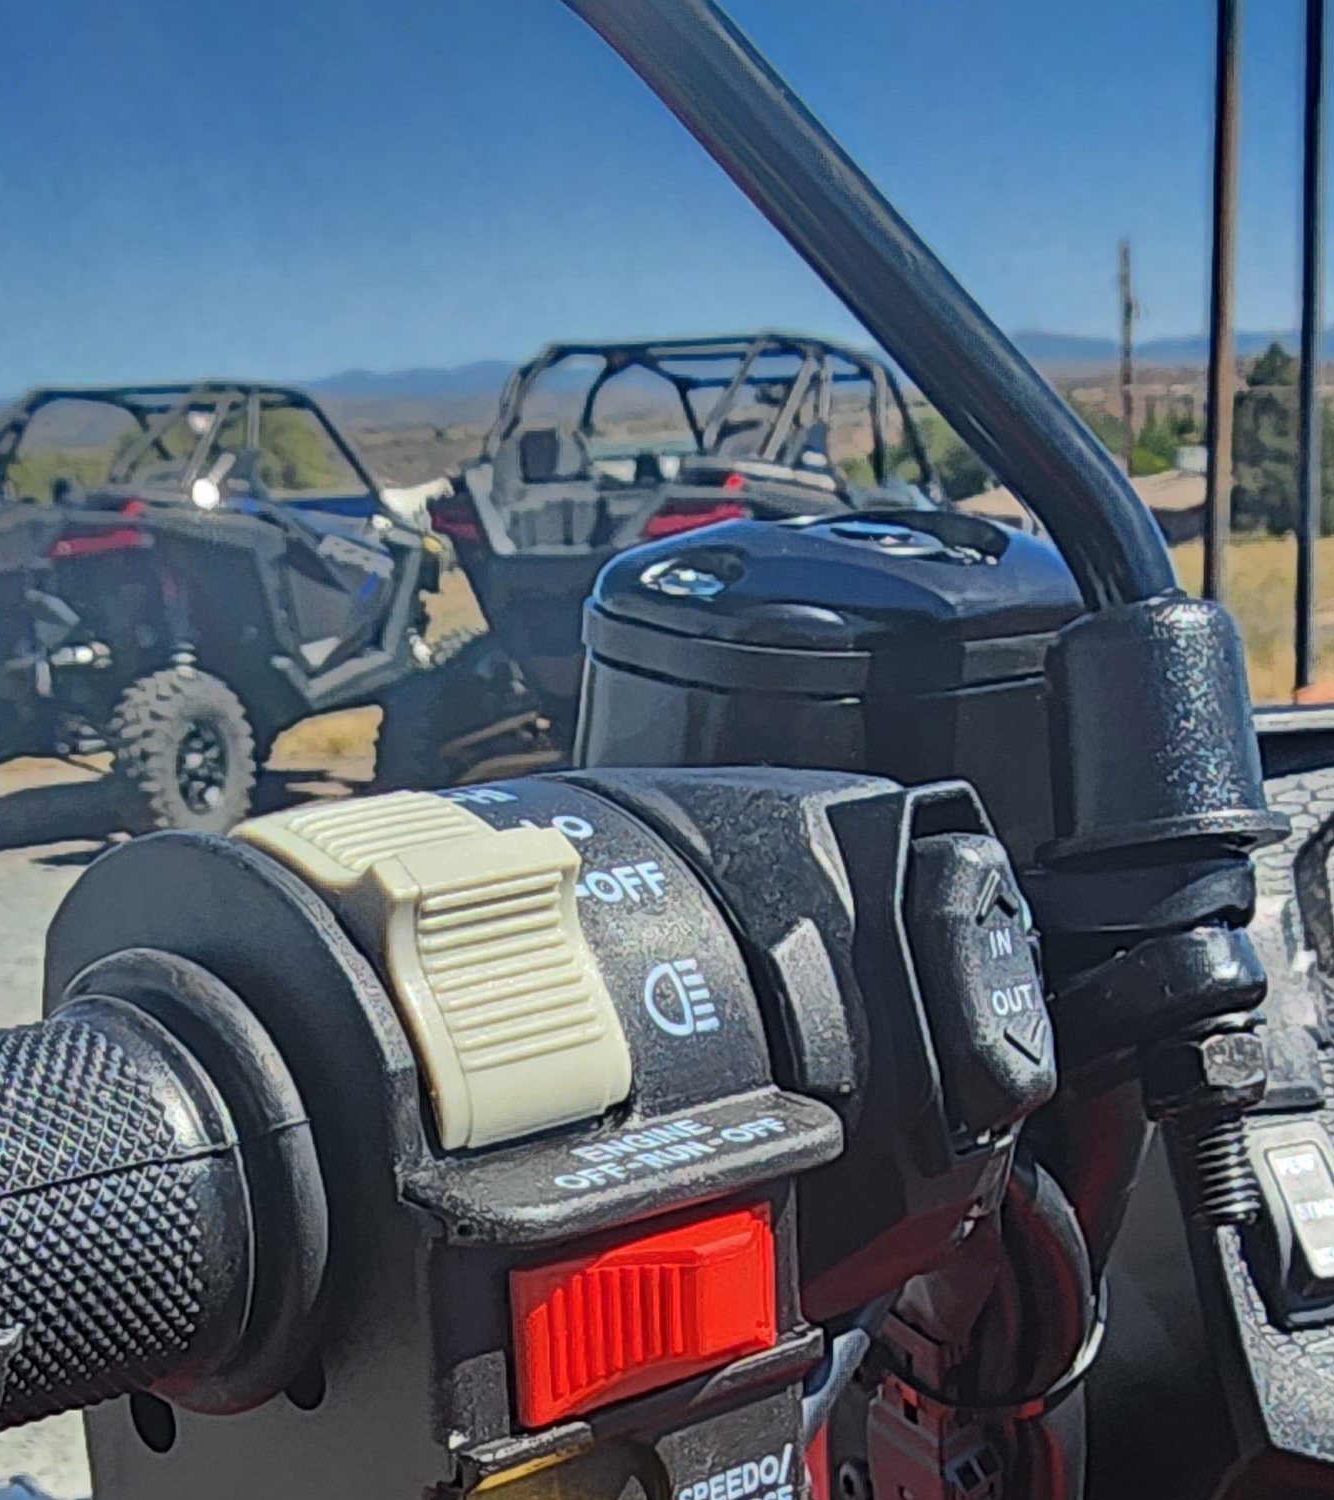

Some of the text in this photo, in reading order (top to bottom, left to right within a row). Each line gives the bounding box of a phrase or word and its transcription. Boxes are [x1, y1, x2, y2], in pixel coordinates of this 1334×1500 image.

[989, 927, 1012, 959] IN
[992, 984, 1034, 1016] OUT
[571, 1118, 713, 1162] ENGINE
